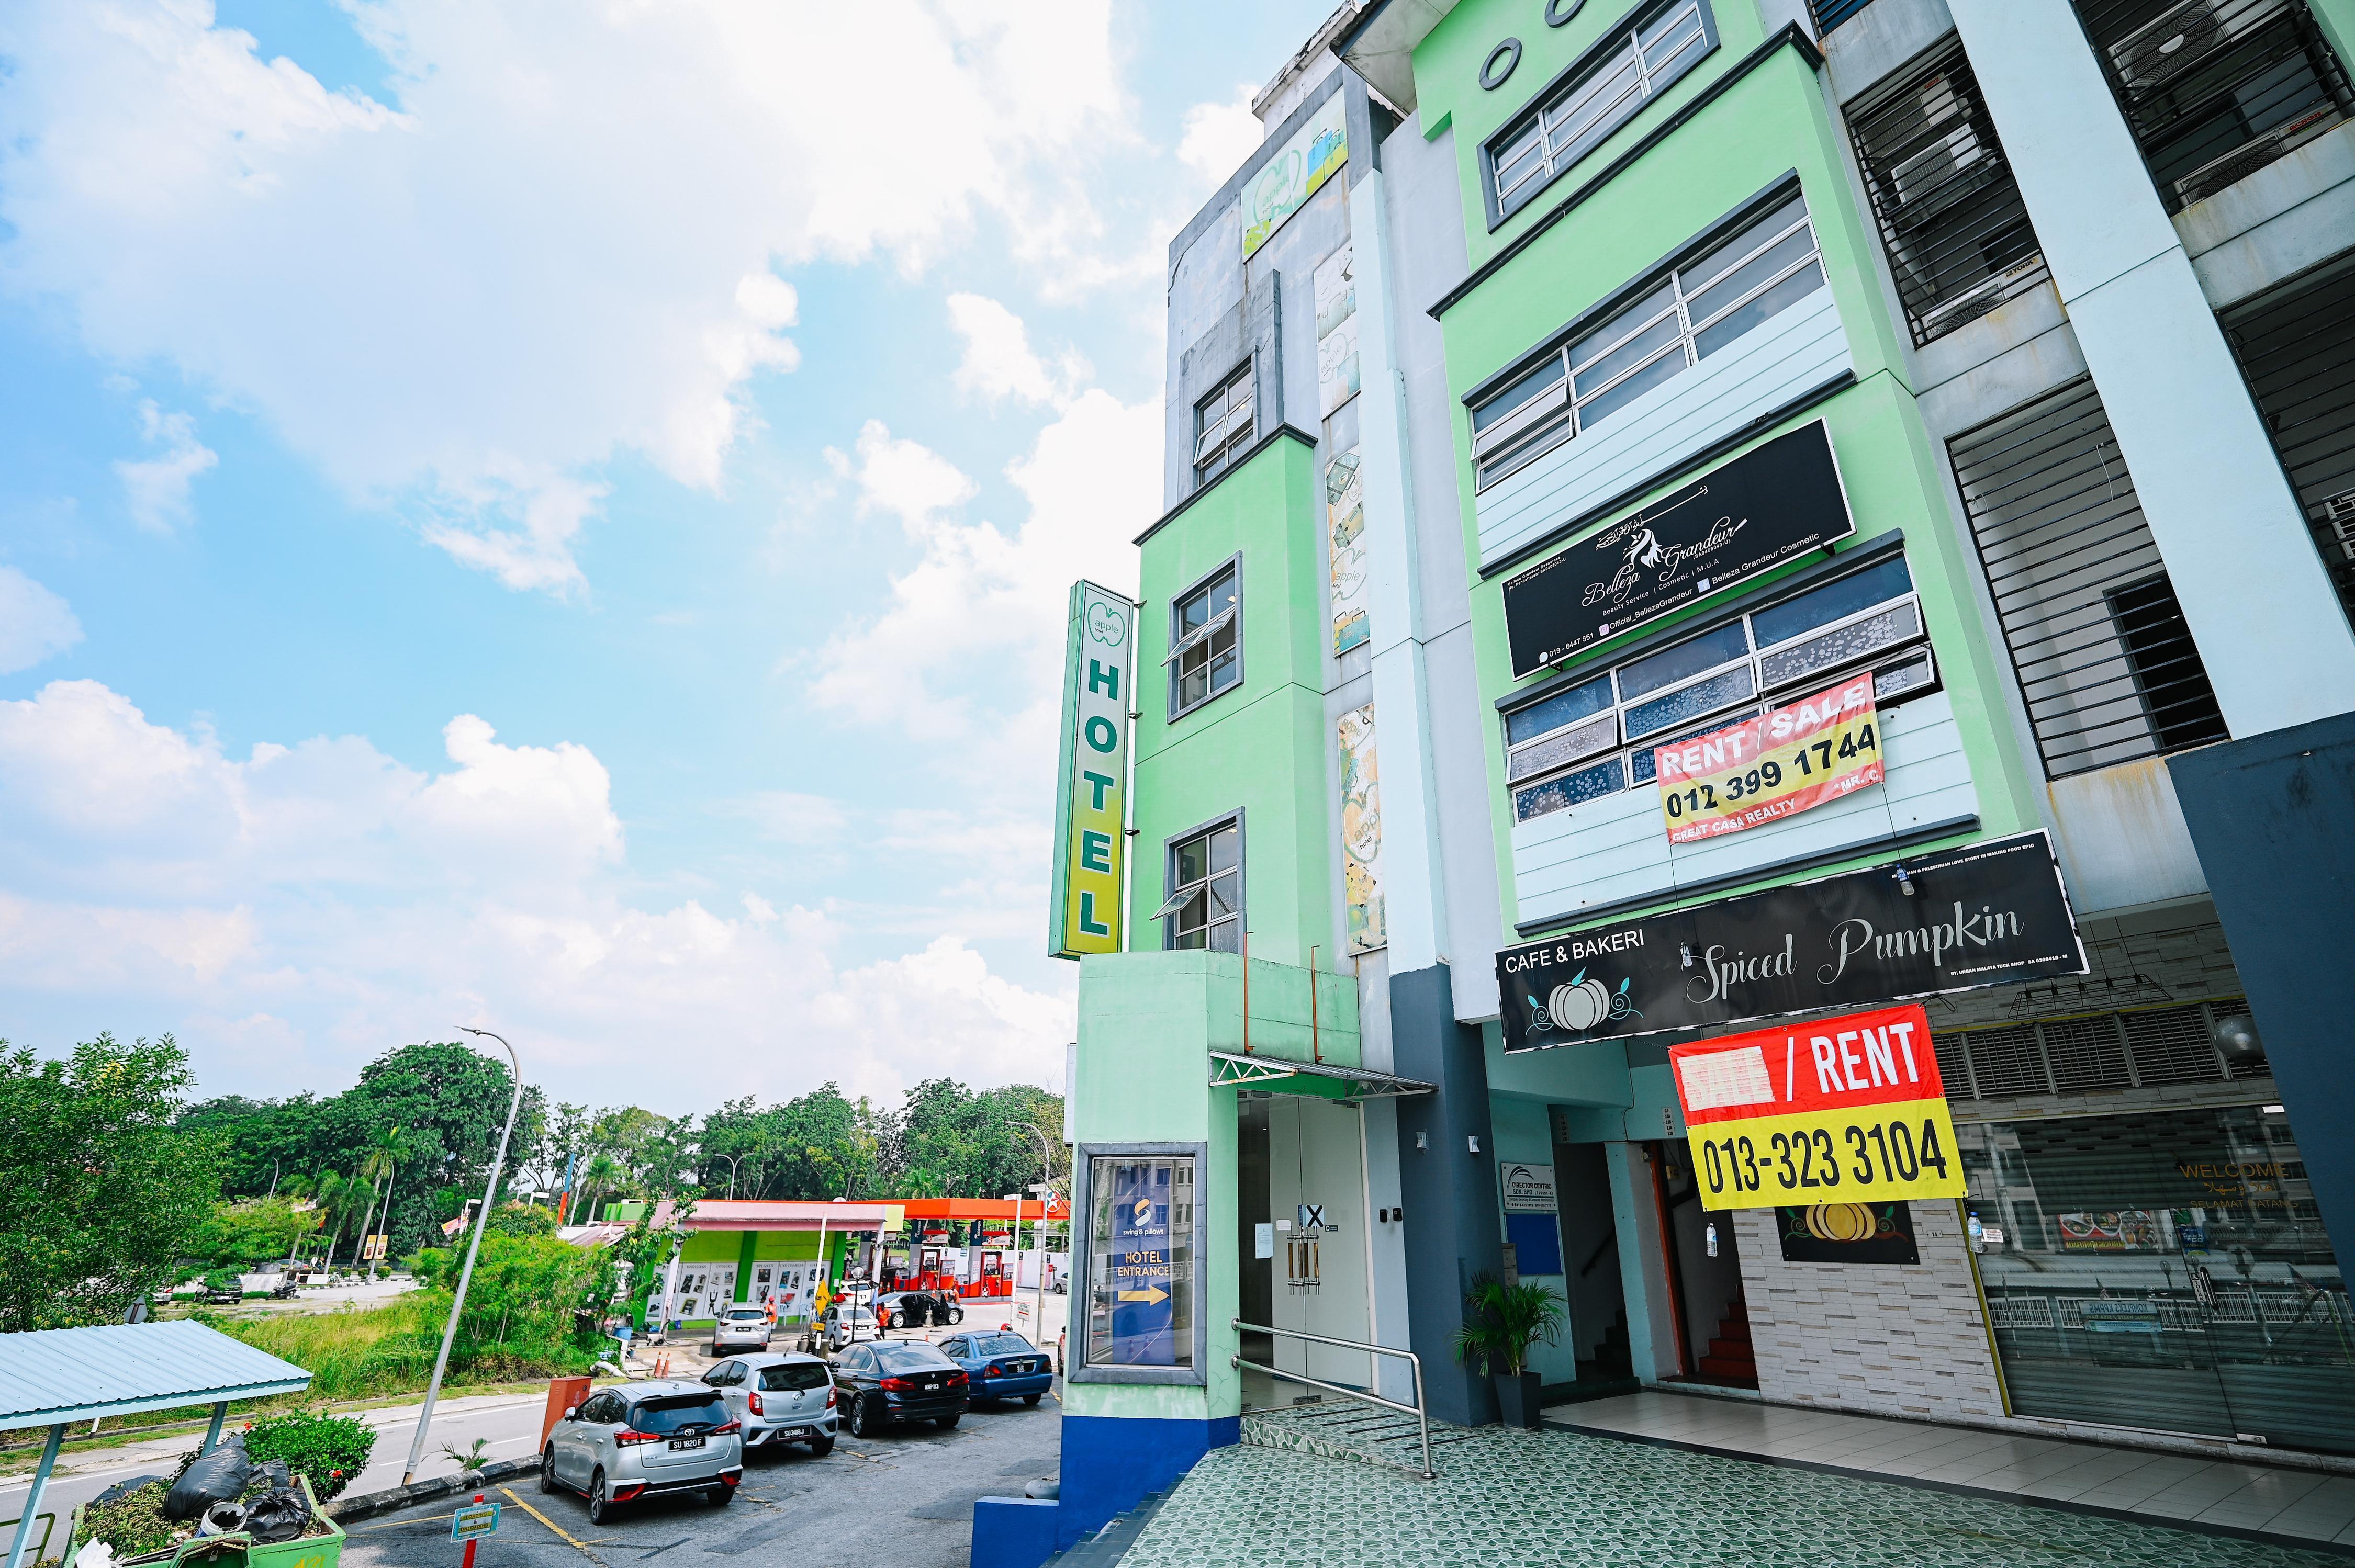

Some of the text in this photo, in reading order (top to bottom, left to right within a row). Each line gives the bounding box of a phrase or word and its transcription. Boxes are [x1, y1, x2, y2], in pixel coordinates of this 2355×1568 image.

[2012, 258, 2034, 273] YORK
[1582, 516, 1736, 607] Belleza Grandeur
[1712, 532, 1820, 585] Belleza Grandeur Cosmetic
[1334, 569, 1360, 584] apple
[1602, 558, 1719, 616] Beauty Service Cosmetic M.U.A
[1609, 589, 1692, 630] Official_BellezaGrandeur
[1095, 619, 1118, 634] apple
[1549, 647, 1561, 657] 019
[1565, 638, 1580, 650] 6447
[1582, 631, 1594, 643] 551
[1661, 730, 1746, 777] RENT
[1770, 681, 1867, 738] SALE
[1666, 724, 1877, 818] 012 399 1744
[1079, 658, 1119, 938] HOTEL
[1672, 797, 1796, 842] GREAT CASA REALTY
[1360, 835, 1372, 850] hotel
[1922, 862, 1951, 873] PALESTINIAN
[1987, 849, 2007, 858] MAKING
[1505, 929, 1645, 973] CAFE & BAKERI
[1682, 901, 2025, 1003] Spiced Pumpkin
[1786, 1036, 1794, 1102] /
[1810, 1022, 1919, 1093] RENT
[1703, 1119, 1947, 1193] 013-323 3104
[2179, 1163, 2289, 1178] WELCOME
[2190, 1200, 2244, 1209] SELAMAT
[1125, 1251, 1163, 1264] HOTEL
[1117, 1266, 1170, 1277] ENTRANCE
[2194, 1280, 2204, 1301] TOLAK
[683, 1439, 697, 1448] 1820
[461, 1523, 489, 1532] UNLOADING
